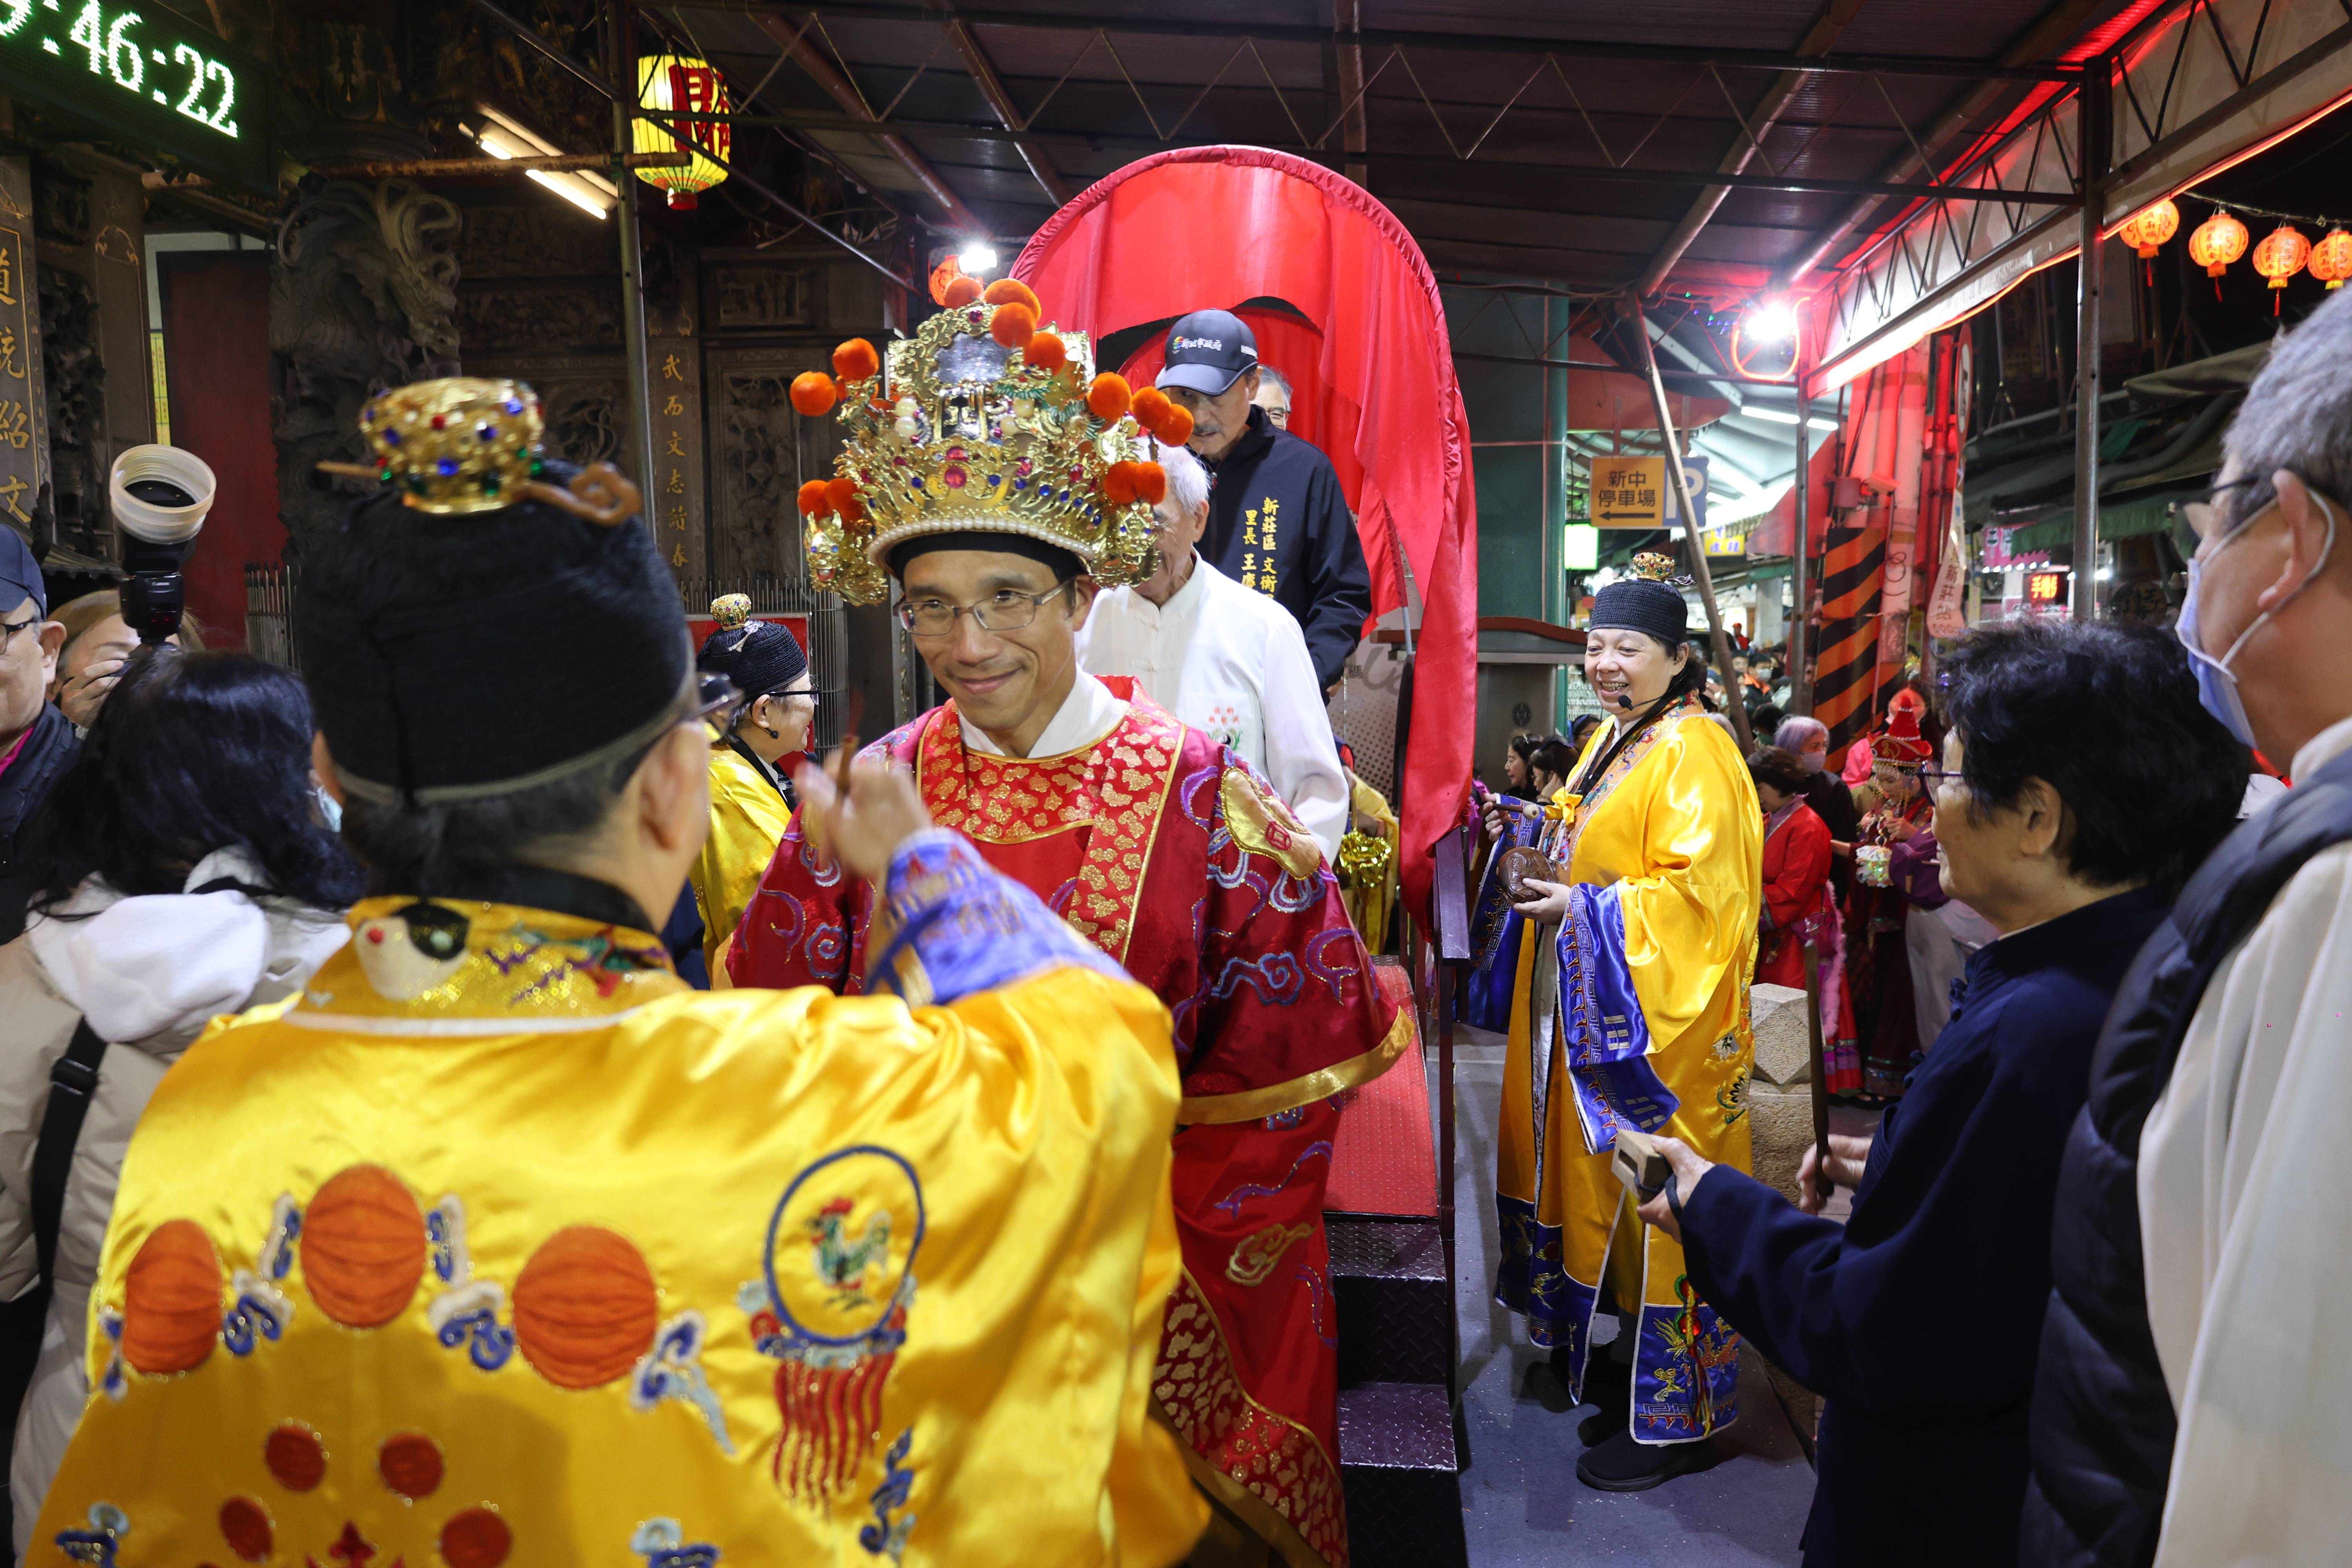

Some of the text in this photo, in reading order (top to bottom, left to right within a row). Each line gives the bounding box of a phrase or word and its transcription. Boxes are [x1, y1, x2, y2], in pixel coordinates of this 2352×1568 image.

[1608, 470, 1646, 488] 新中
[1665, 466, 1704, 519] P
[1598, 489, 1656, 508] 停車場
[1243, 510, 1258, 545] 里長
[1259, 497, 1280, 599] 新莊區 文衡
